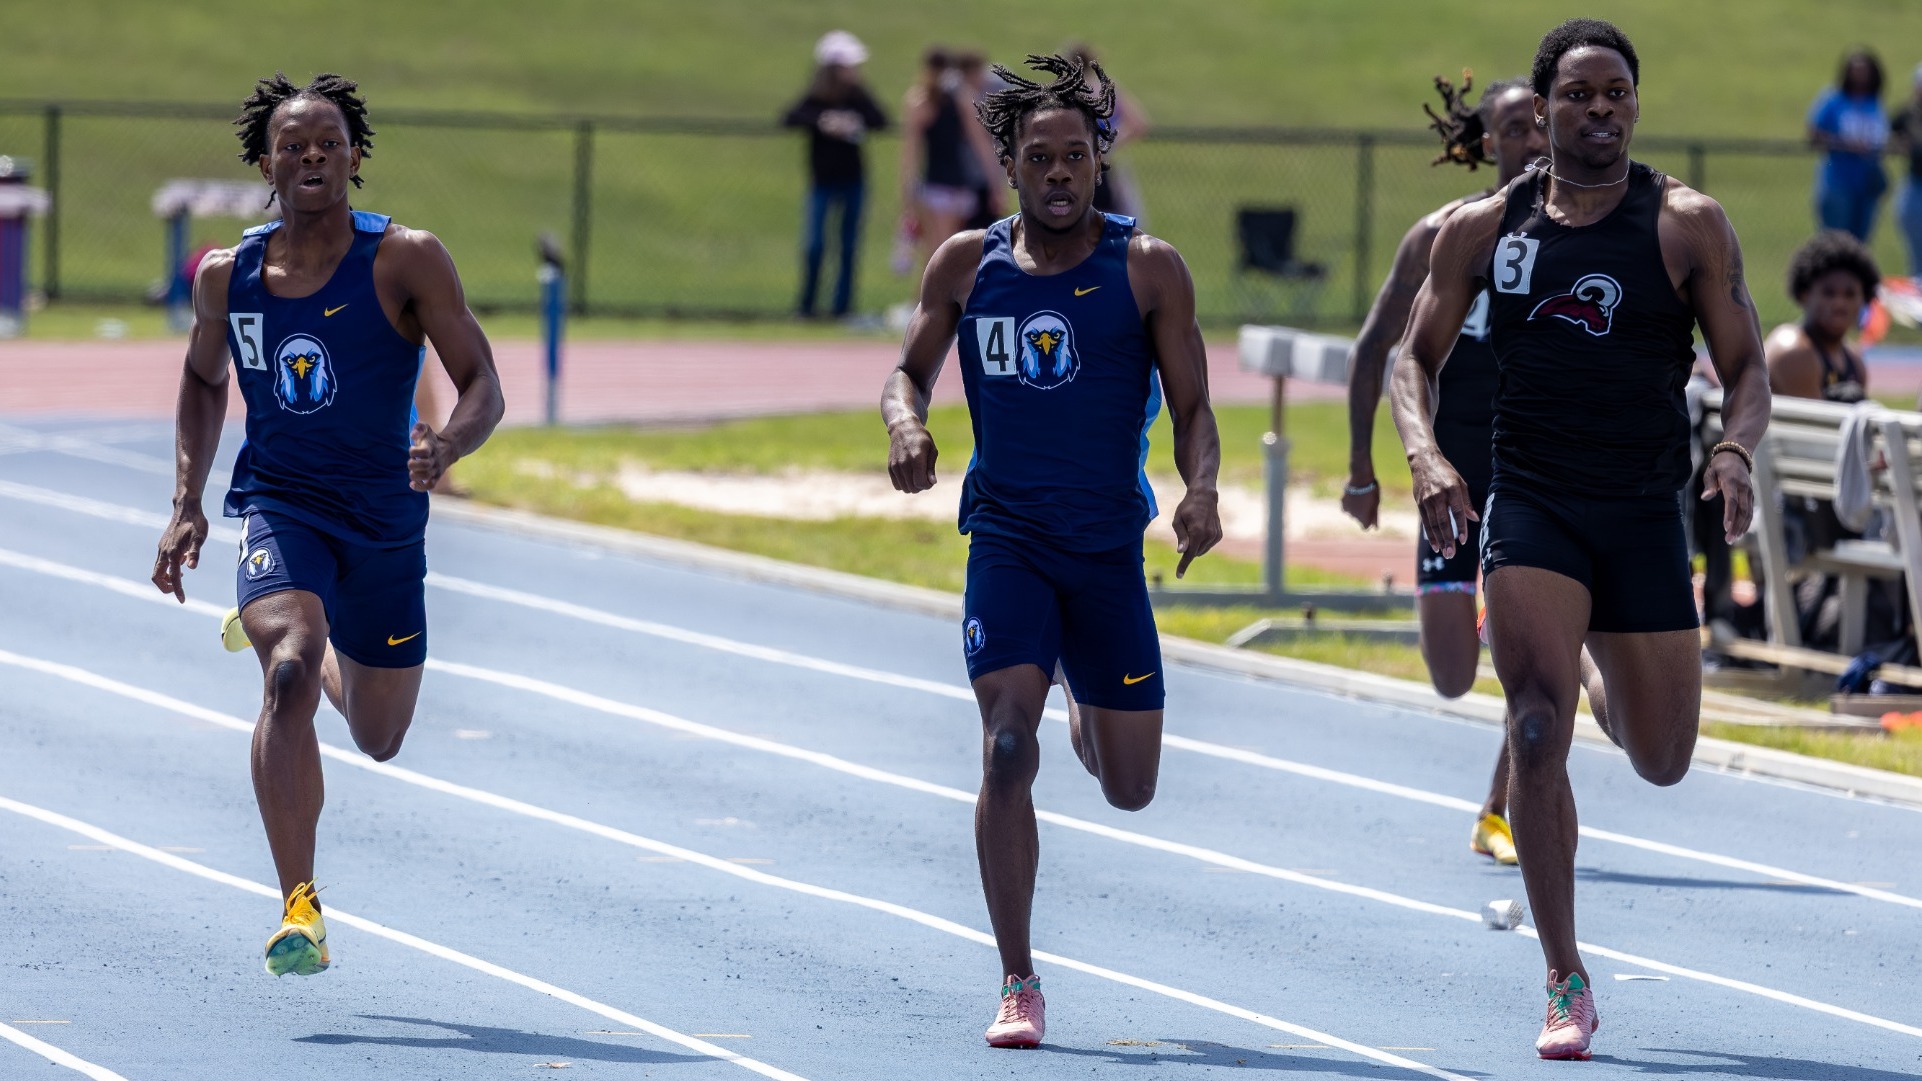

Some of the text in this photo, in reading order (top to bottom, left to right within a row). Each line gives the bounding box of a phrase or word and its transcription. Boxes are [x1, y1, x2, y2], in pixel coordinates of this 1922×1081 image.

[1501, 240, 1528, 291] 3
[238, 317, 259, 367] 5
[986, 321, 1010, 372] 4
